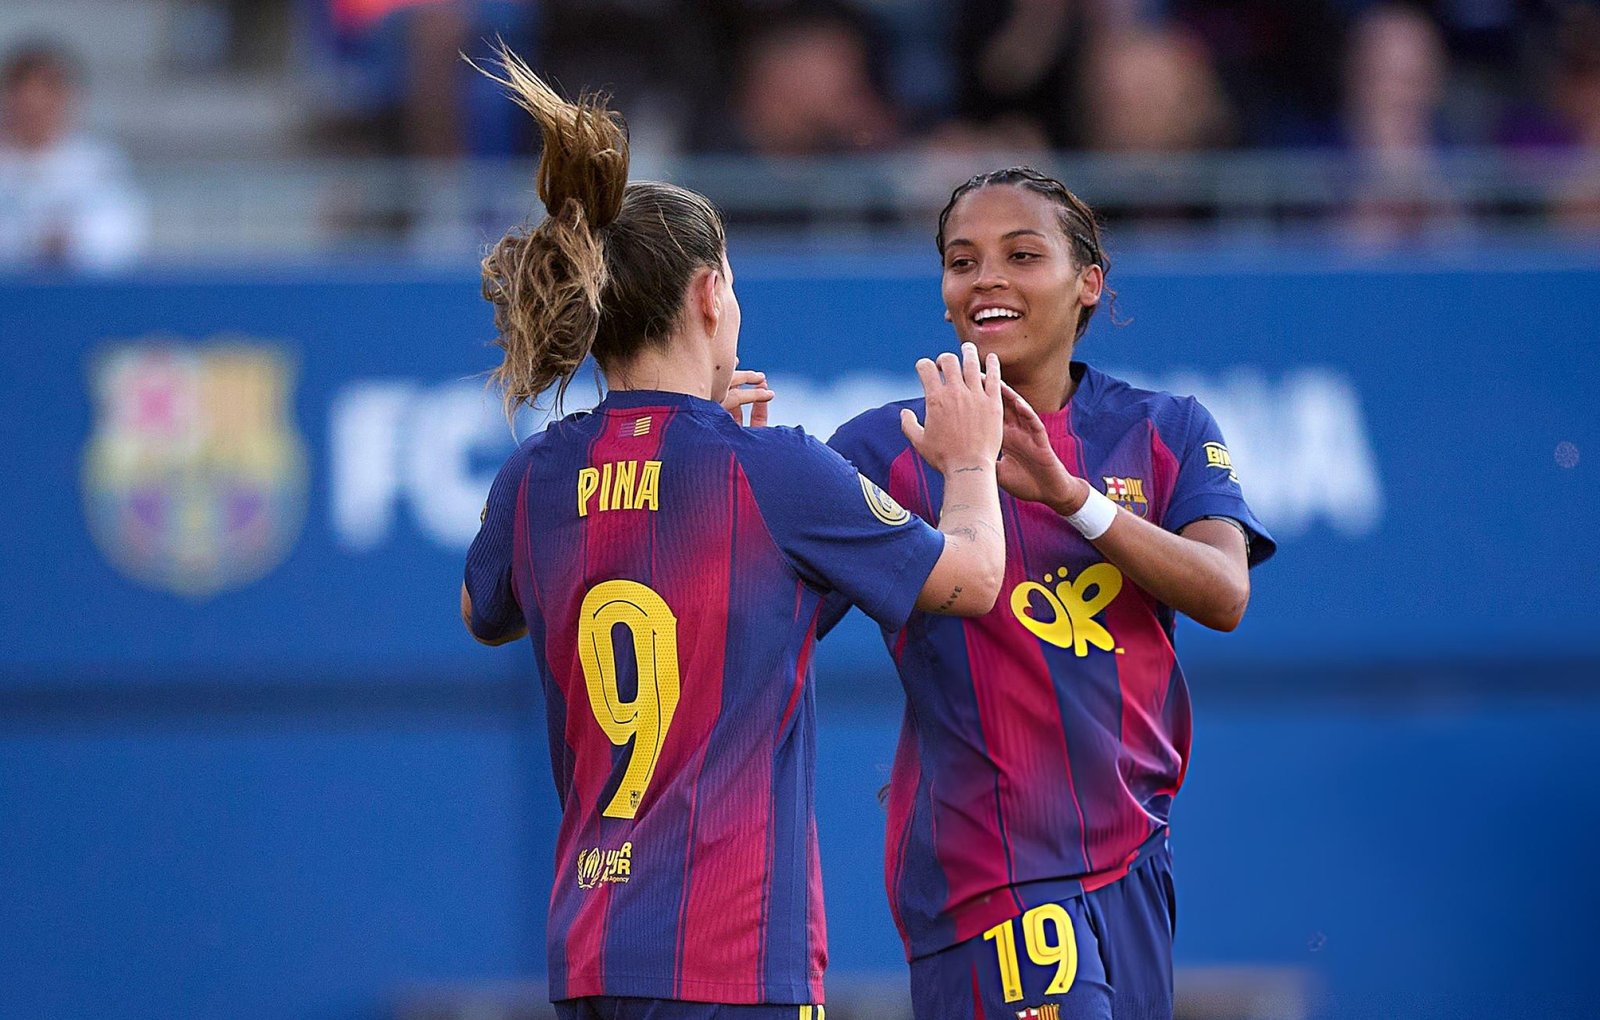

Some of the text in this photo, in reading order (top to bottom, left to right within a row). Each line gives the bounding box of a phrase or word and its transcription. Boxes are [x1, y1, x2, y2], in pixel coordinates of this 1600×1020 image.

[577, 460, 663, 517] PINA
[578, 579, 681, 819] 9
[983, 903, 1078, 1003] 19
